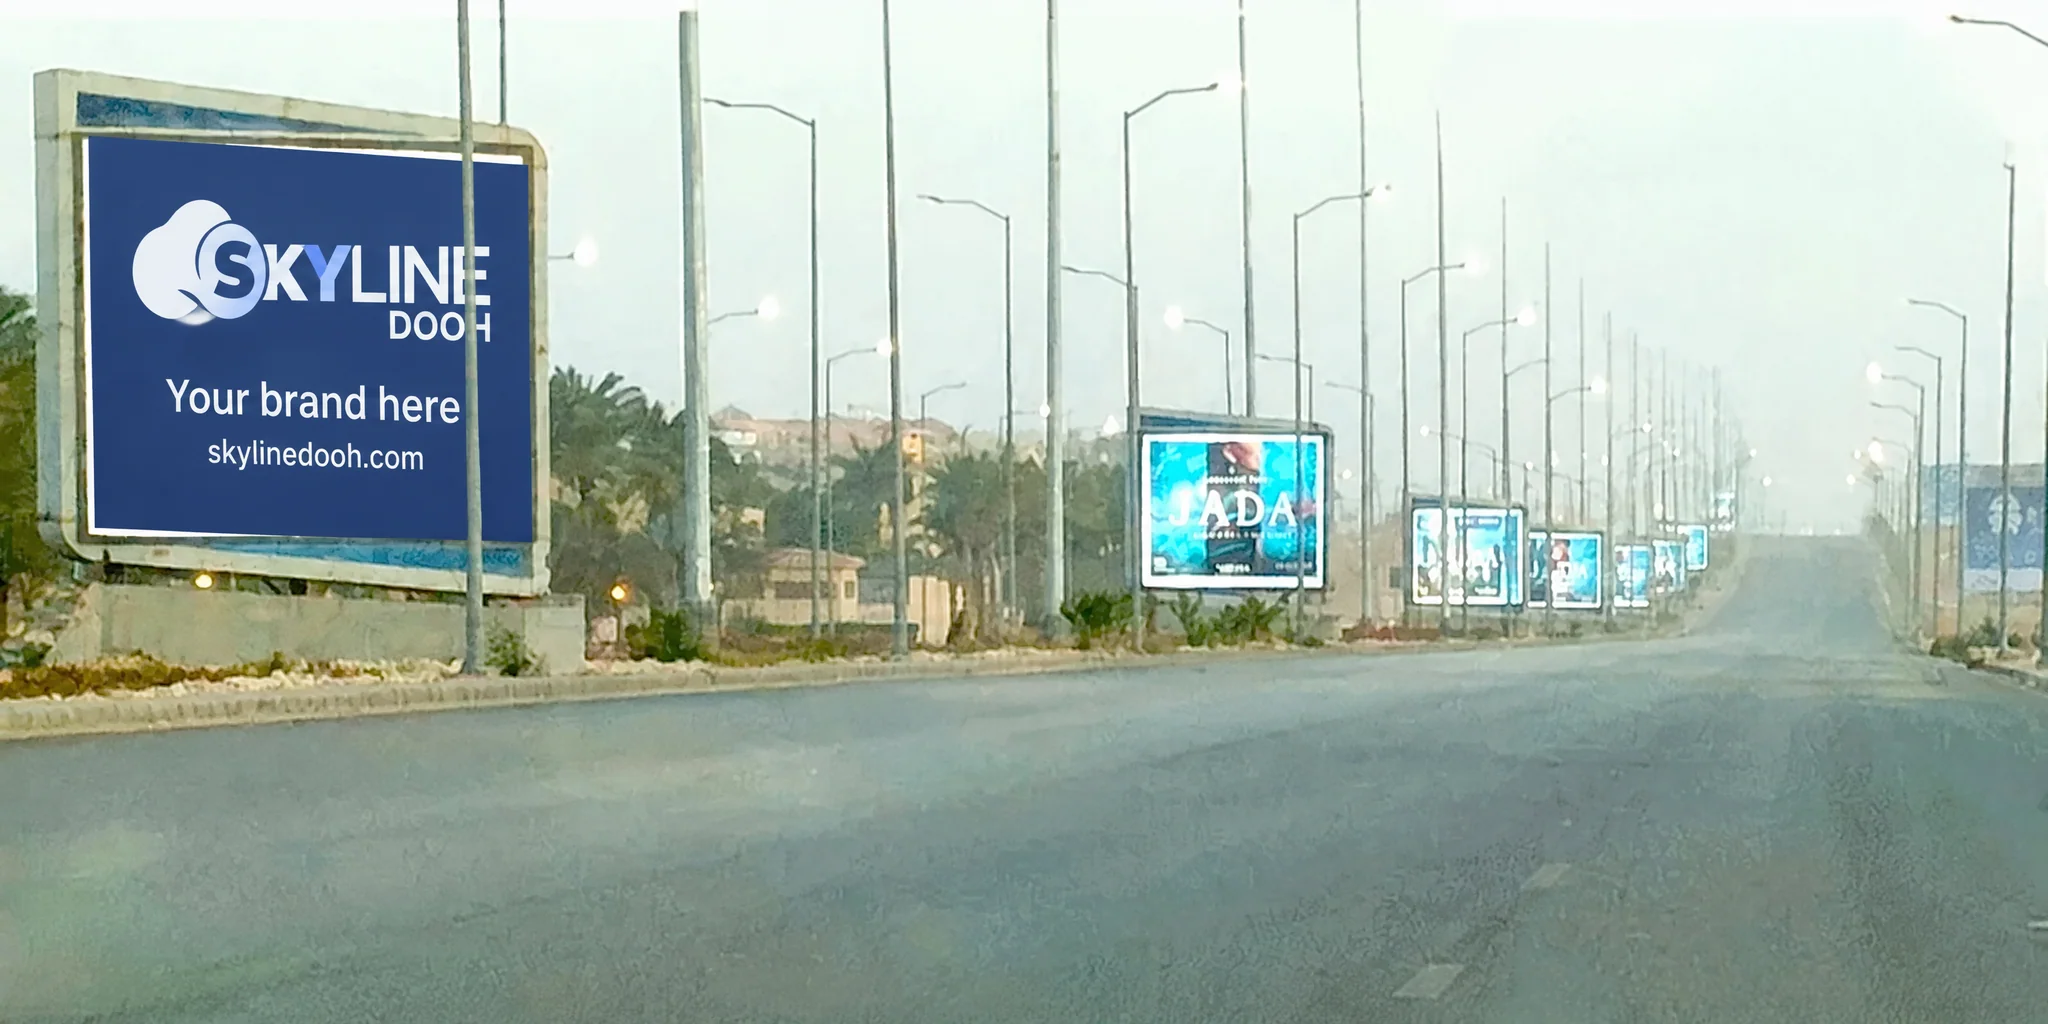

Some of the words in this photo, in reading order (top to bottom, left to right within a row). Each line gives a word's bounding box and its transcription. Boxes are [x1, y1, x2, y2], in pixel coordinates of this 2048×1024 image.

[213, 240, 491, 306] SKYLINE
[165, 378, 249, 416] Your
[260, 380, 366, 420] brand
[379, 385, 461, 424] here
[207, 438, 424, 471] skylinedooh.com
[1168, 488, 1298, 528] JADA
